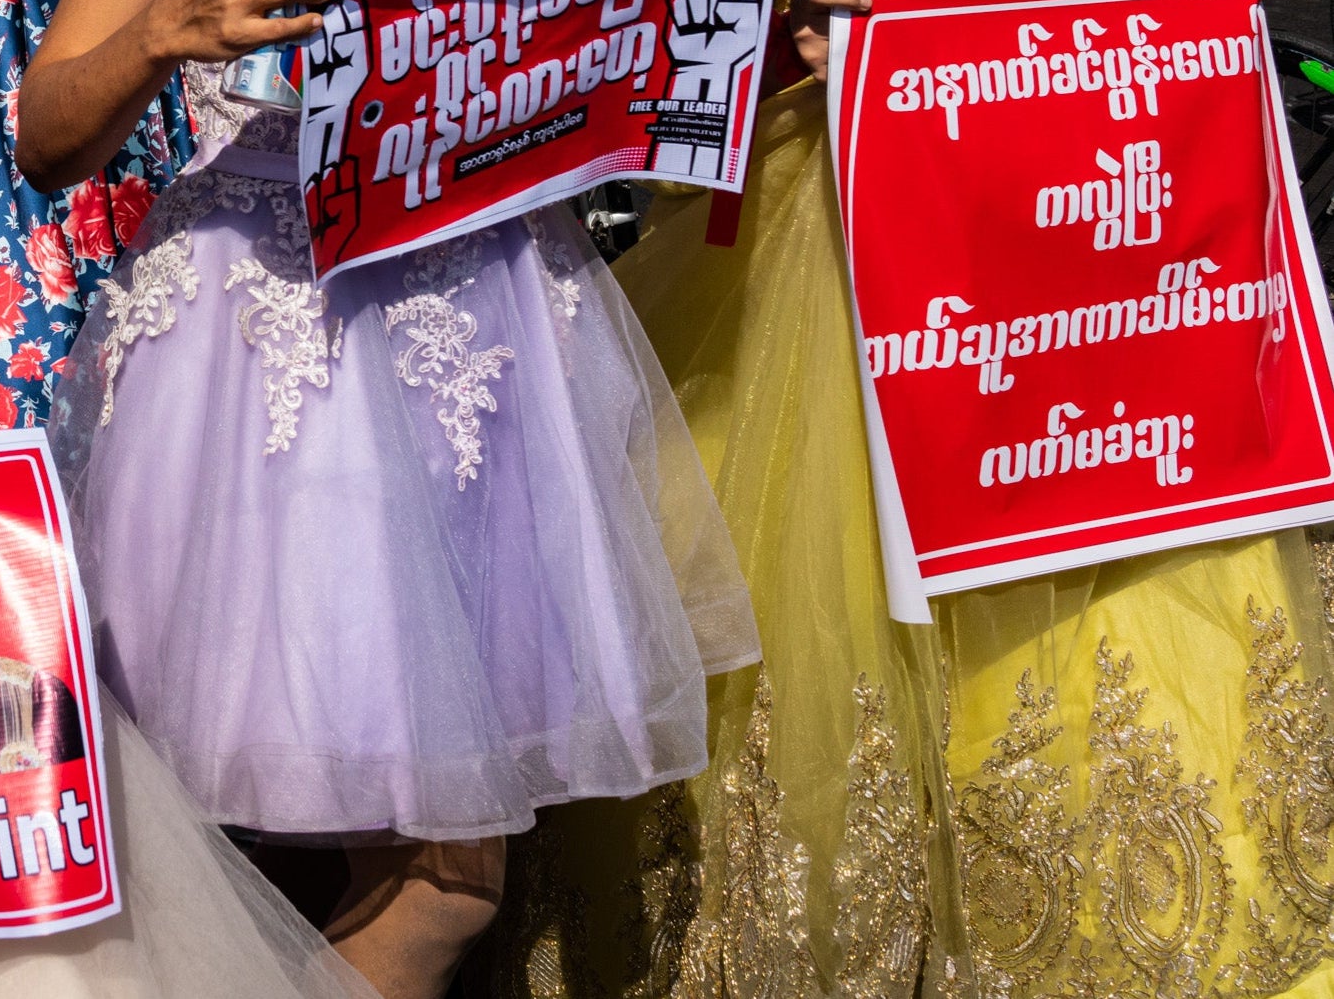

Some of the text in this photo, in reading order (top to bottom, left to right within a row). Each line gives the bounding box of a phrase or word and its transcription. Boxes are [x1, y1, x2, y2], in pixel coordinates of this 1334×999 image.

[629, 100, 727, 116] FREE OUR LEADER
[978, 401, 1195, 488] လက်မခံဘူး
